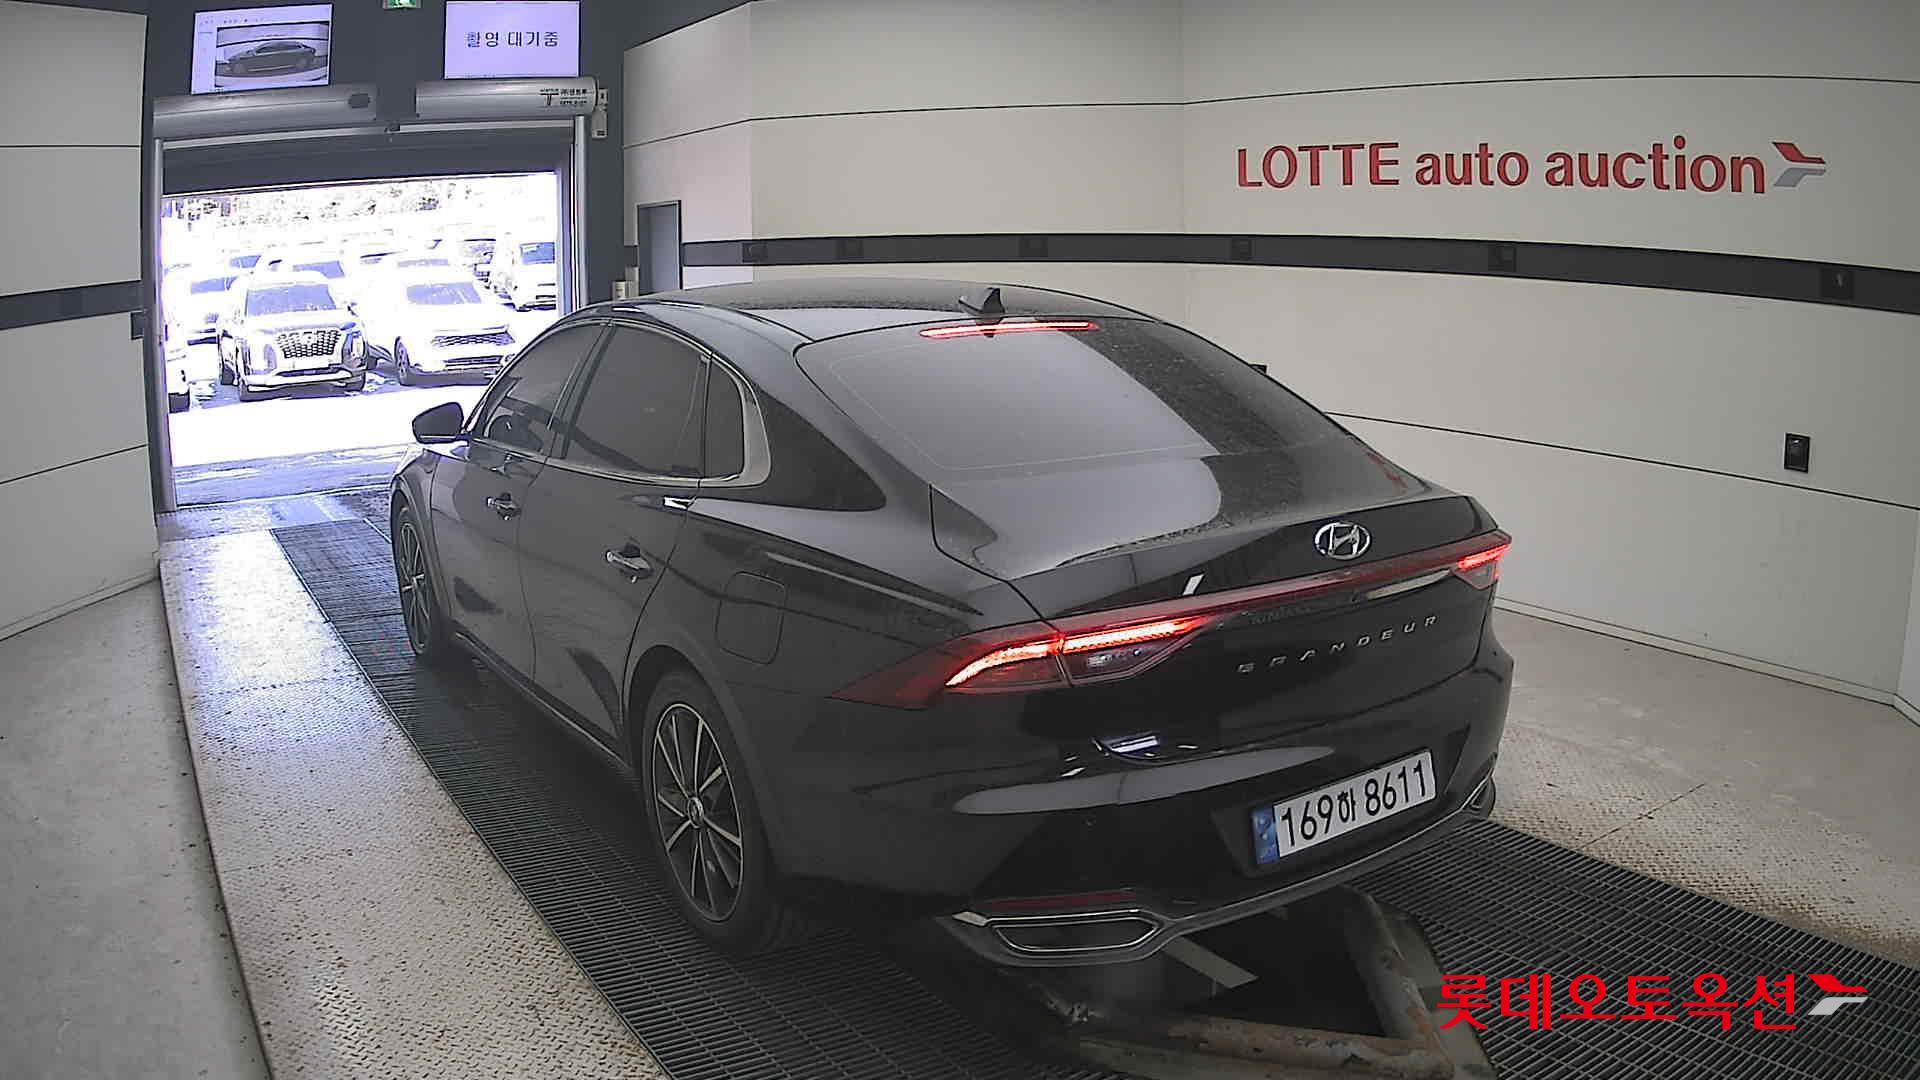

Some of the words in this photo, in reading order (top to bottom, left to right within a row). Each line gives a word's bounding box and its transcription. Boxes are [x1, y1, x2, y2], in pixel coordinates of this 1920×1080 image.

[507, 31, 559, 48] 대기중
[1237, 142, 1400, 188] LOTTE
[1414, 142, 1530, 188] auto
[1544, 135, 1766, 195] auction
[1237, 614, 1438, 674] GRANDEUR
[1364, 759, 1427, 817] 8611
